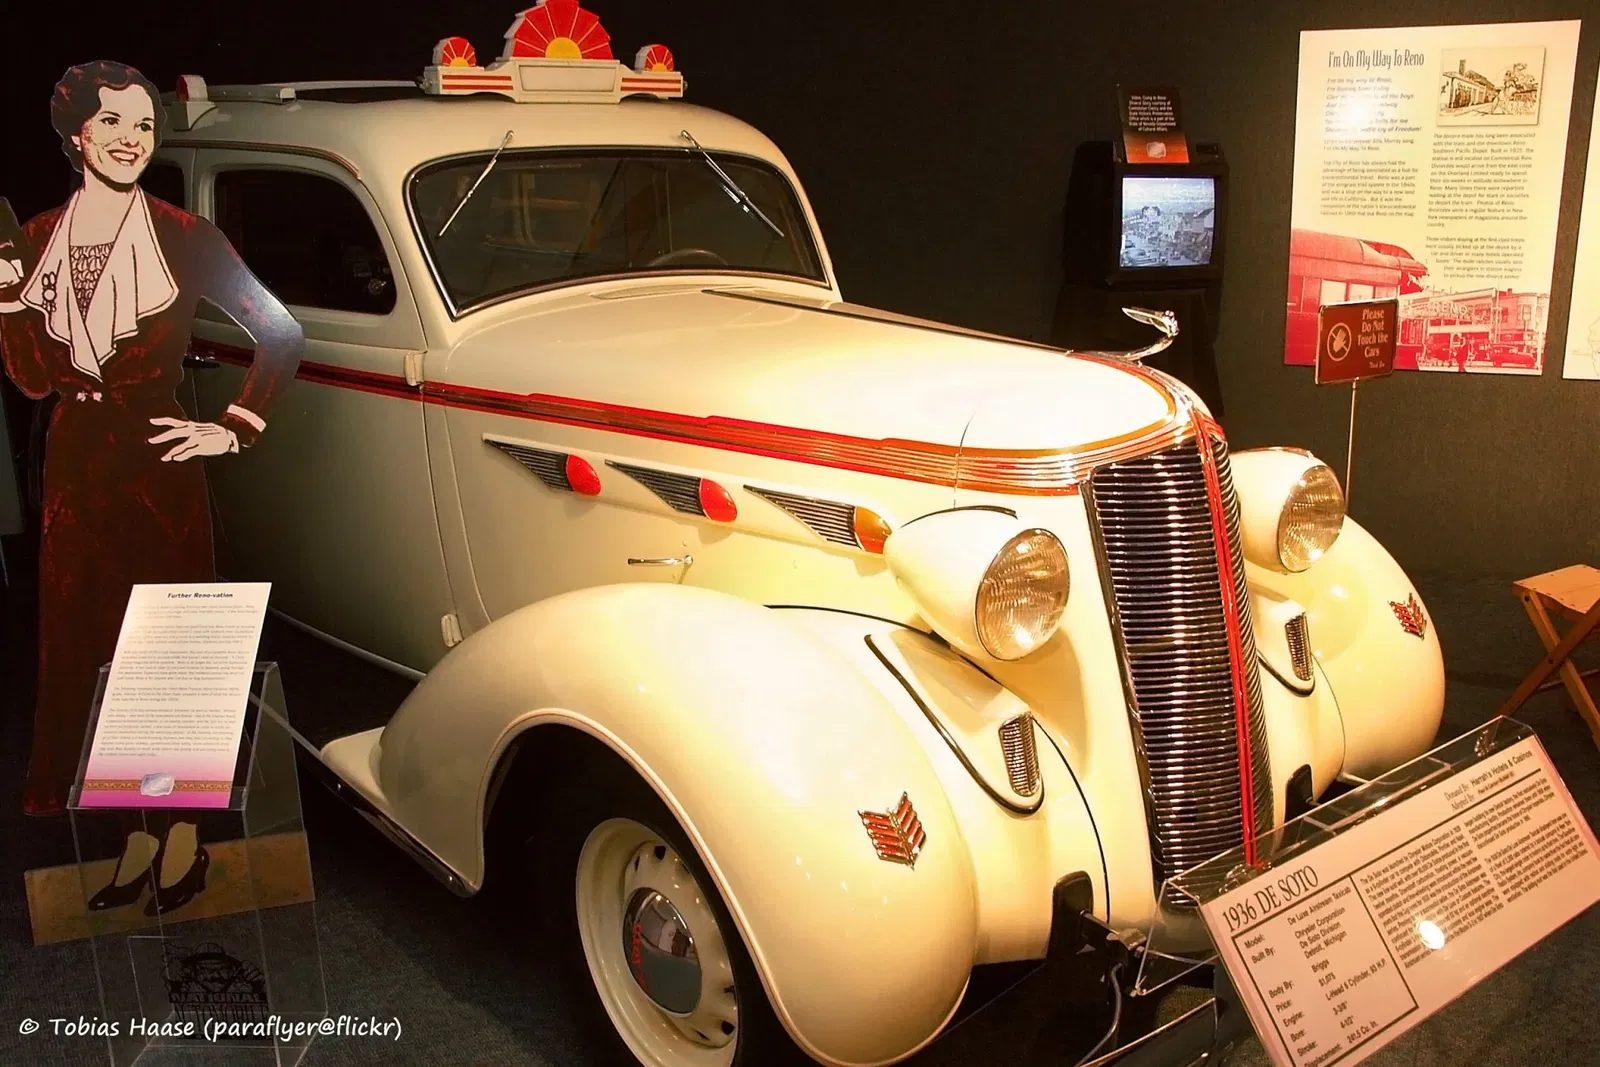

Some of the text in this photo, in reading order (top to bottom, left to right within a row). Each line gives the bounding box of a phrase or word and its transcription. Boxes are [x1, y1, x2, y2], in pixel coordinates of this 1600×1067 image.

[1329, 49, 1425, 70] I'm On My Way To Reno
[1362, 309, 1384, 320] Please
[1362, 320, 1384, 332] Do Not
[1357, 334, 1376, 345] Touch
[1364, 347, 1379, 358] Cars
[1470, 772, 1492, 787] Harrah's
[1491, 763, 1509, 775] Hotels
[1512, 751, 1532, 764] Casinos
[1223, 866, 1318, 932] 1936 DE SOTO
[1244, 887, 1351, 949] Model: De Luxe Airstream Taxicab
[1251, 907, 1345, 964] Built By: Chrysler Corporation
[1299, 922, 1341, 949] De Soto Division
[1323, 931, 1347, 947] Michigan
[1268, 959, 1329, 999] Body By: Briggs
[1276, 972, 1336, 1013] Price: $1,075
[1282, 1012, 1304, 1027] Engine:
[1325, 984, 1344, 1001] L-Head
[1290, 1029, 1306, 1042] Bore:
[1297, 1041, 1317, 1057] Stroke:
